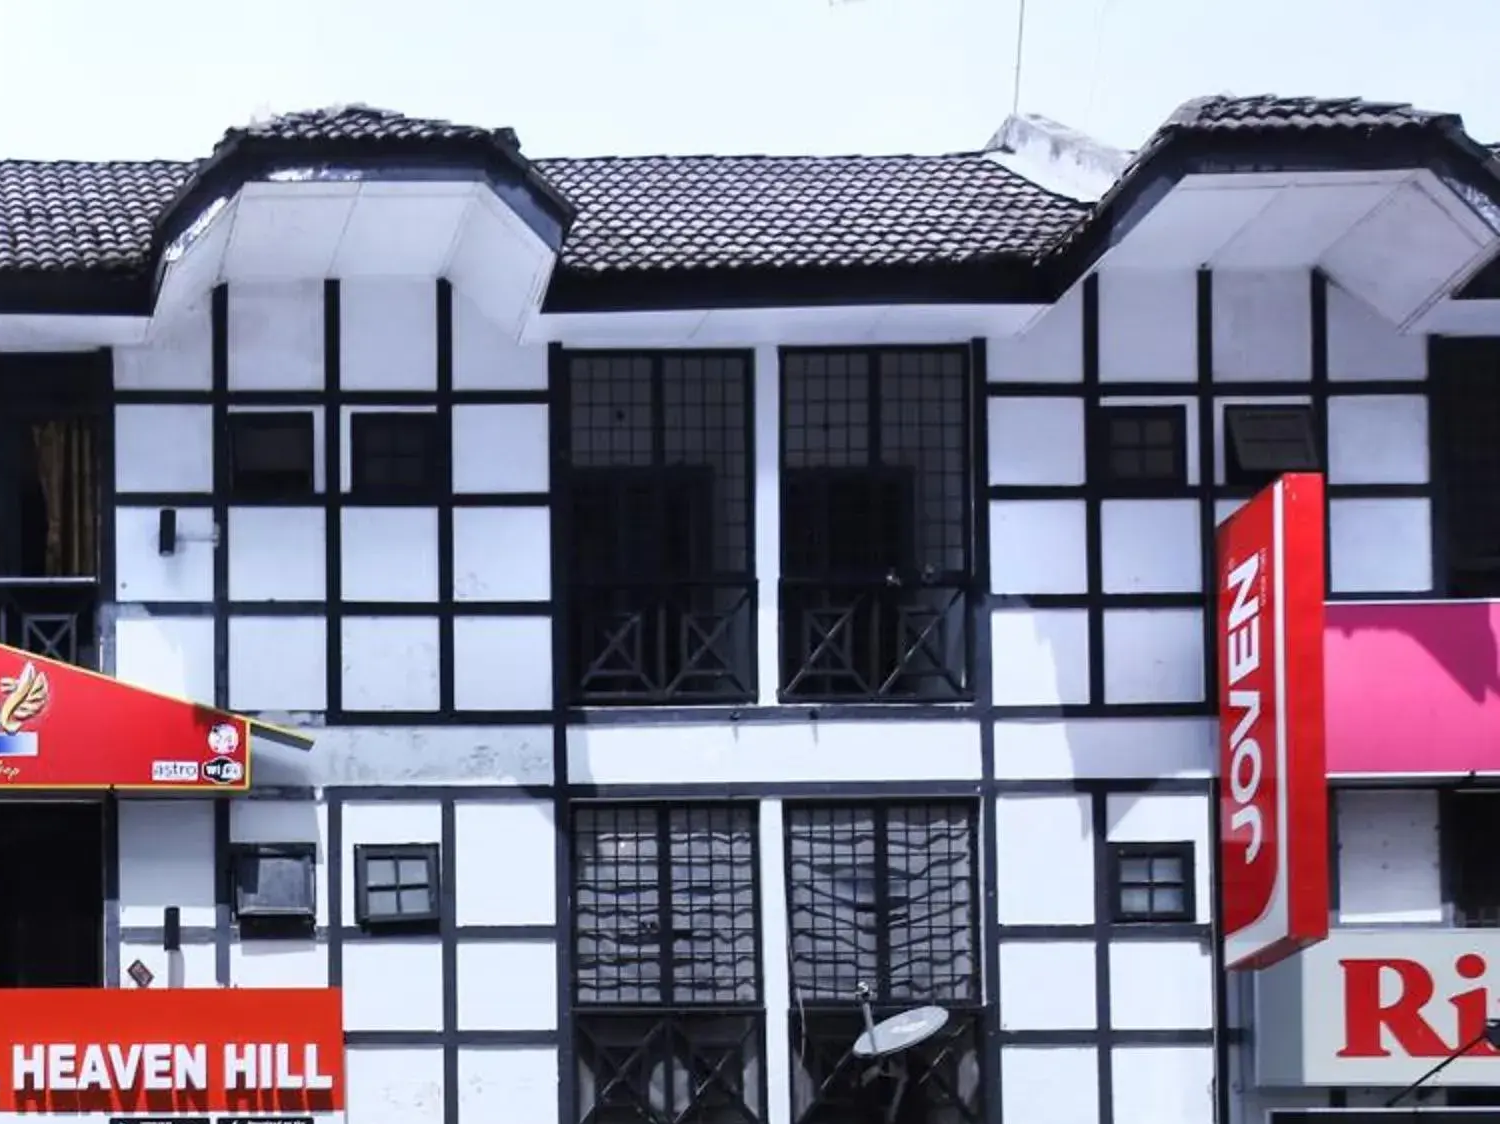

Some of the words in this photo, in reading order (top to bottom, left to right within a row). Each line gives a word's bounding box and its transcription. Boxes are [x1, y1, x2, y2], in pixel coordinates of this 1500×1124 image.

[1228, 552, 1263, 865] JOVEN
[154, 762, 197, 778] astro
[1336, 953, 1500, 1057] Ri
[13, 1044, 206, 1090] HEAVEN
[224, 1044, 333, 1090] HILL
